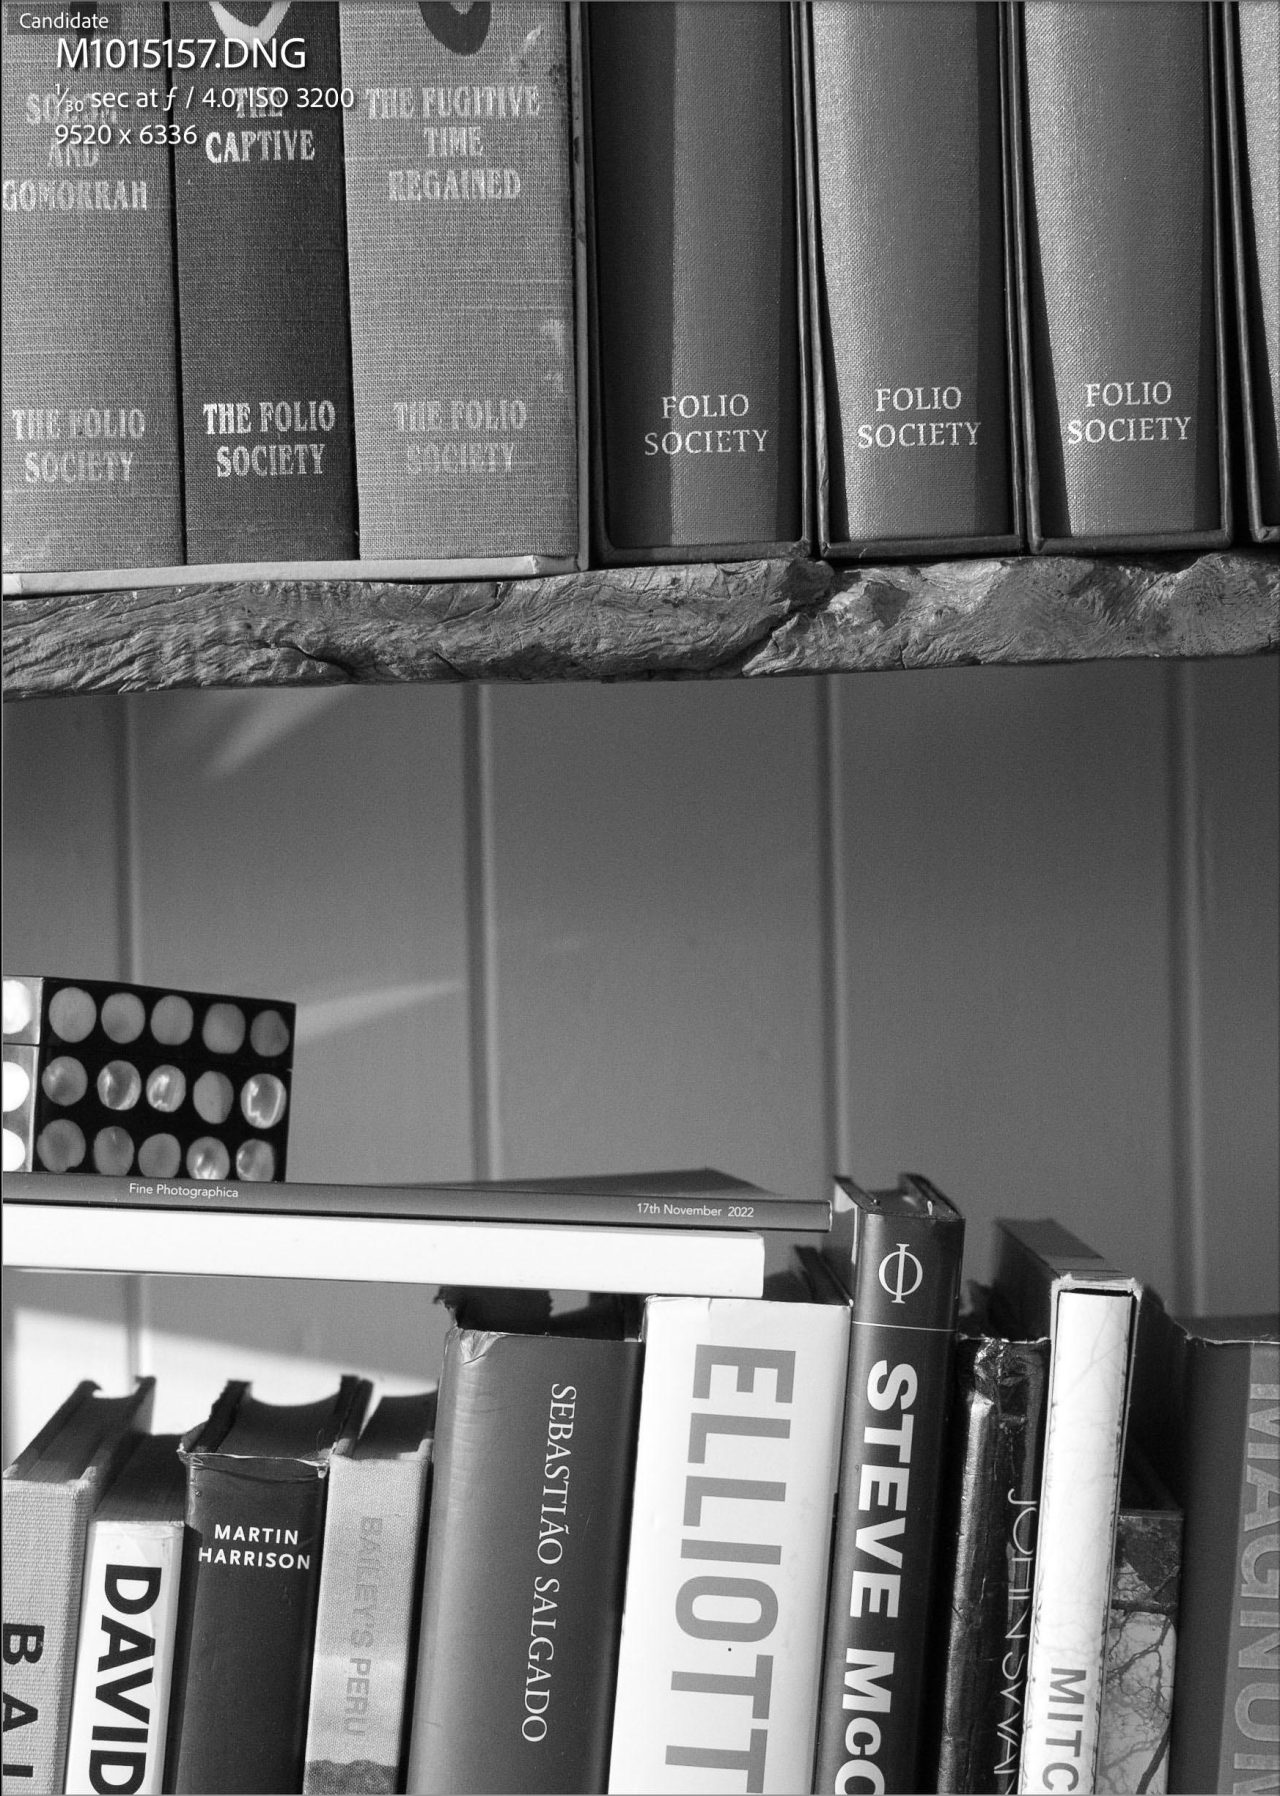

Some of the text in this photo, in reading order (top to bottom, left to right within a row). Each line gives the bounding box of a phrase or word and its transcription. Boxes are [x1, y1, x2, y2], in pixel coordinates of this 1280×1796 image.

[366, 85, 542, 119] THE FUGITIVE
[205, 130, 316, 164] CAPTIVE
[424, 126, 484, 158] TIME
[2, 178, 148, 212] GOMORRAH
[387, 169, 522, 202] REGAINED
[661, 393, 749, 418] FOLIO
[874, 386, 962, 411] FOLIO
[1084, 381, 1172, 407] FOLIO
[12, 408, 145, 440] THE FOLIO
[203, 400, 335, 435] THE FOLIO
[393, 400, 526, 432] THE FOLIO
[1067, 416, 1192, 444] SOCIETY
[644, 429, 769, 456] SOCIETY
[857, 422, 981, 448] SOCIETY
[25, 451, 134, 483] SOCIETY
[216, 444, 325, 477] SOCIETY
[129, 1183, 240, 1199] Fine Photographica
[637, 1203, 755, 1218] 17th November 2022
[849, 1359, 919, 1619] STEVE
[214, 1523, 300, 1550] MARTIN
[197, 1547, 312, 1572] HARRISON
[520, 1382, 579, 1744] SEBASTIÃO SALGADO
[664, 1343, 797, 1794] ELLIOTT
[87, 1563, 163, 1794] DAVID
[343, 1656, 372, 1737] PERU
